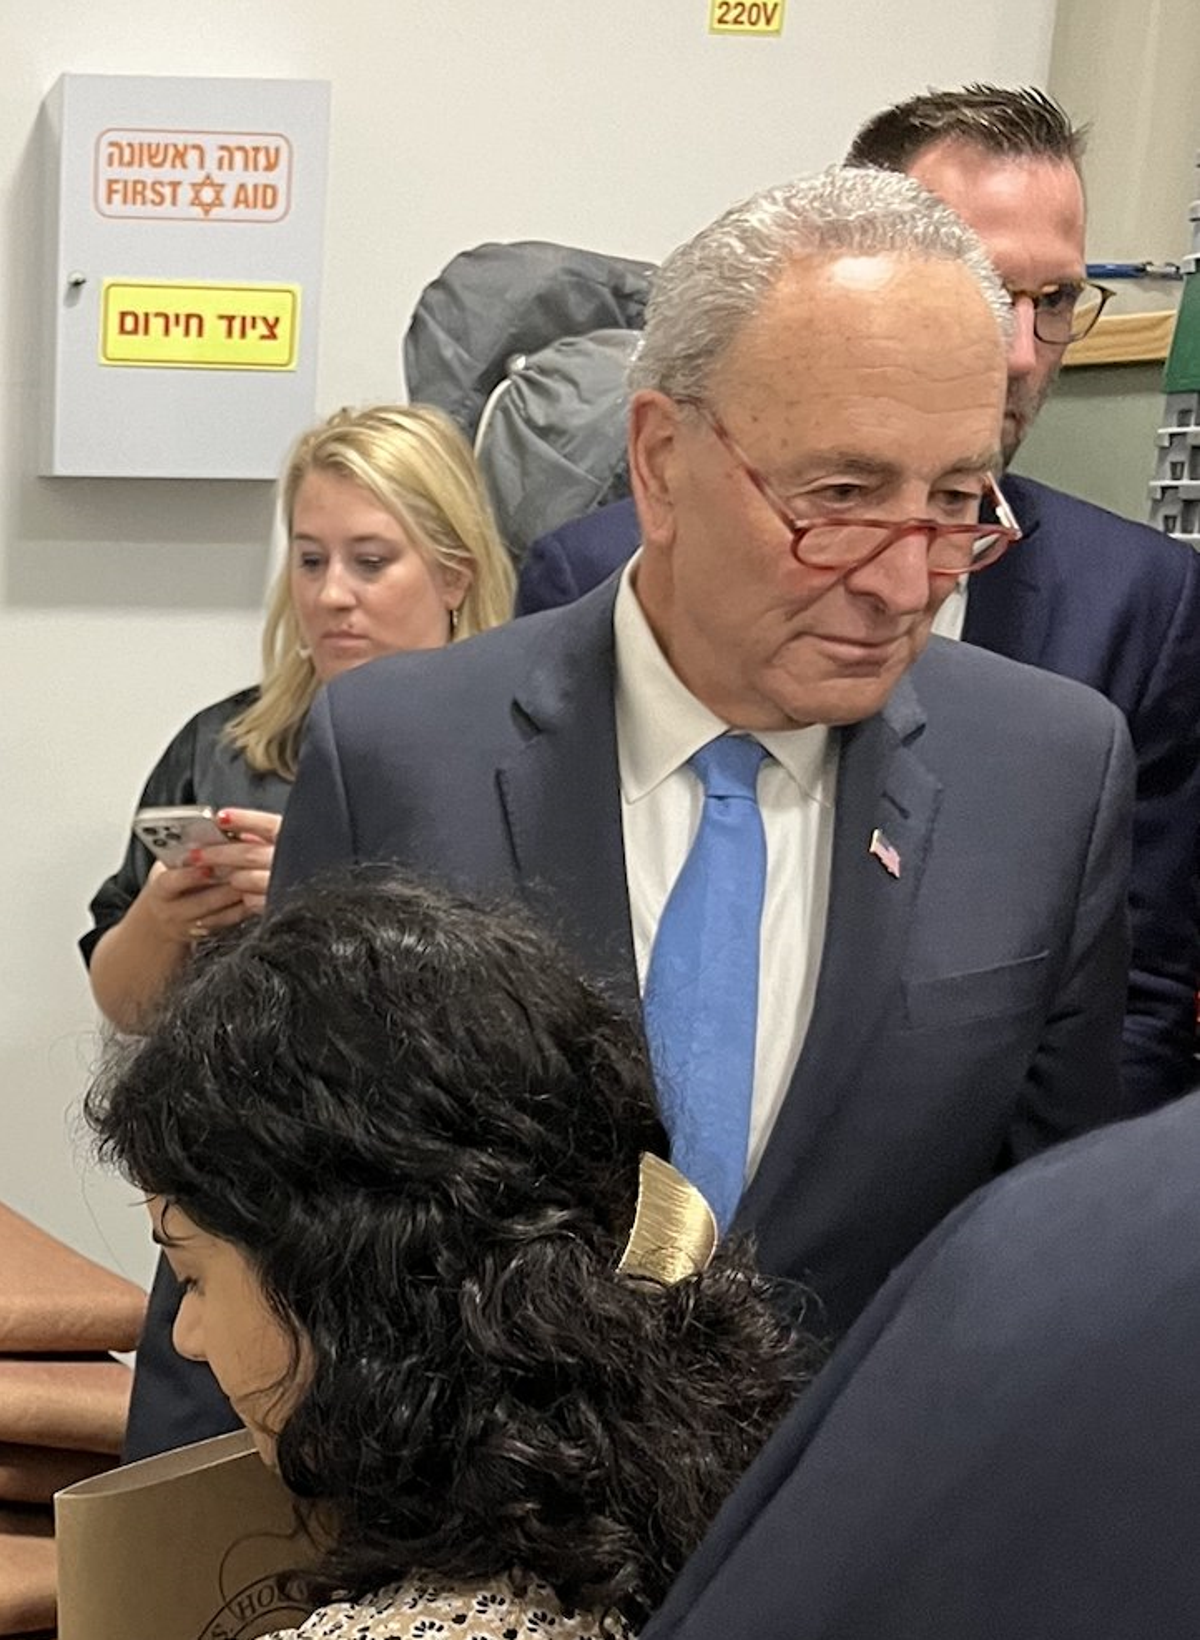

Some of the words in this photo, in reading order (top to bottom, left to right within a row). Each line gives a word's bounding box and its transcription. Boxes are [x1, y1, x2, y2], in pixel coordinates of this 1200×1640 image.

[717, 1, 778, 26] 220V
[107, 141, 206, 170] ראשונה
[217, 145, 280, 172] עזרה
[106, 178, 183, 207] FIRST
[232, 183, 279, 209] AID
[118, 311, 204, 338] חירום
[217, 314, 280, 341] ציוד
[236, 1584, 277, 1619] HO
